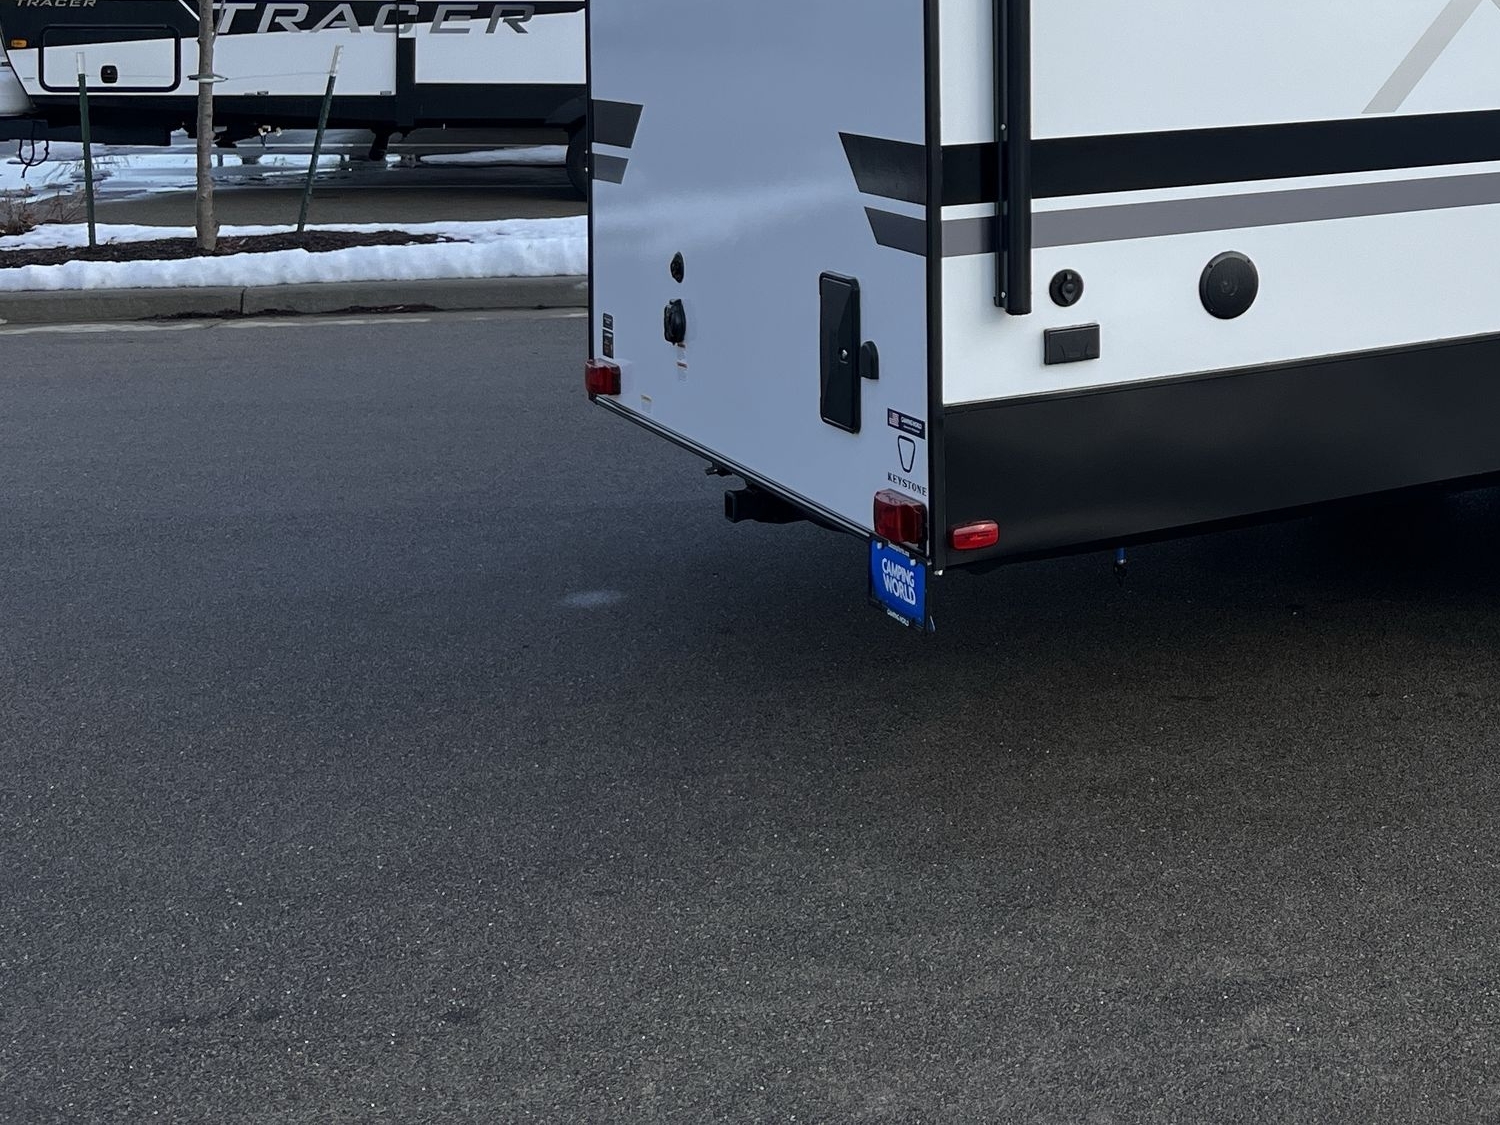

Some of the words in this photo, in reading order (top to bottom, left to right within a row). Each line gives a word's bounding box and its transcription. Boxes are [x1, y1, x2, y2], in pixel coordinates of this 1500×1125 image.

[212, 2, 536, 35] TRACER
[887, 471, 928, 497] KEYSTONE
[881, 557, 916, 588] CAMPING
[882, 573, 917, 606] WORLD
